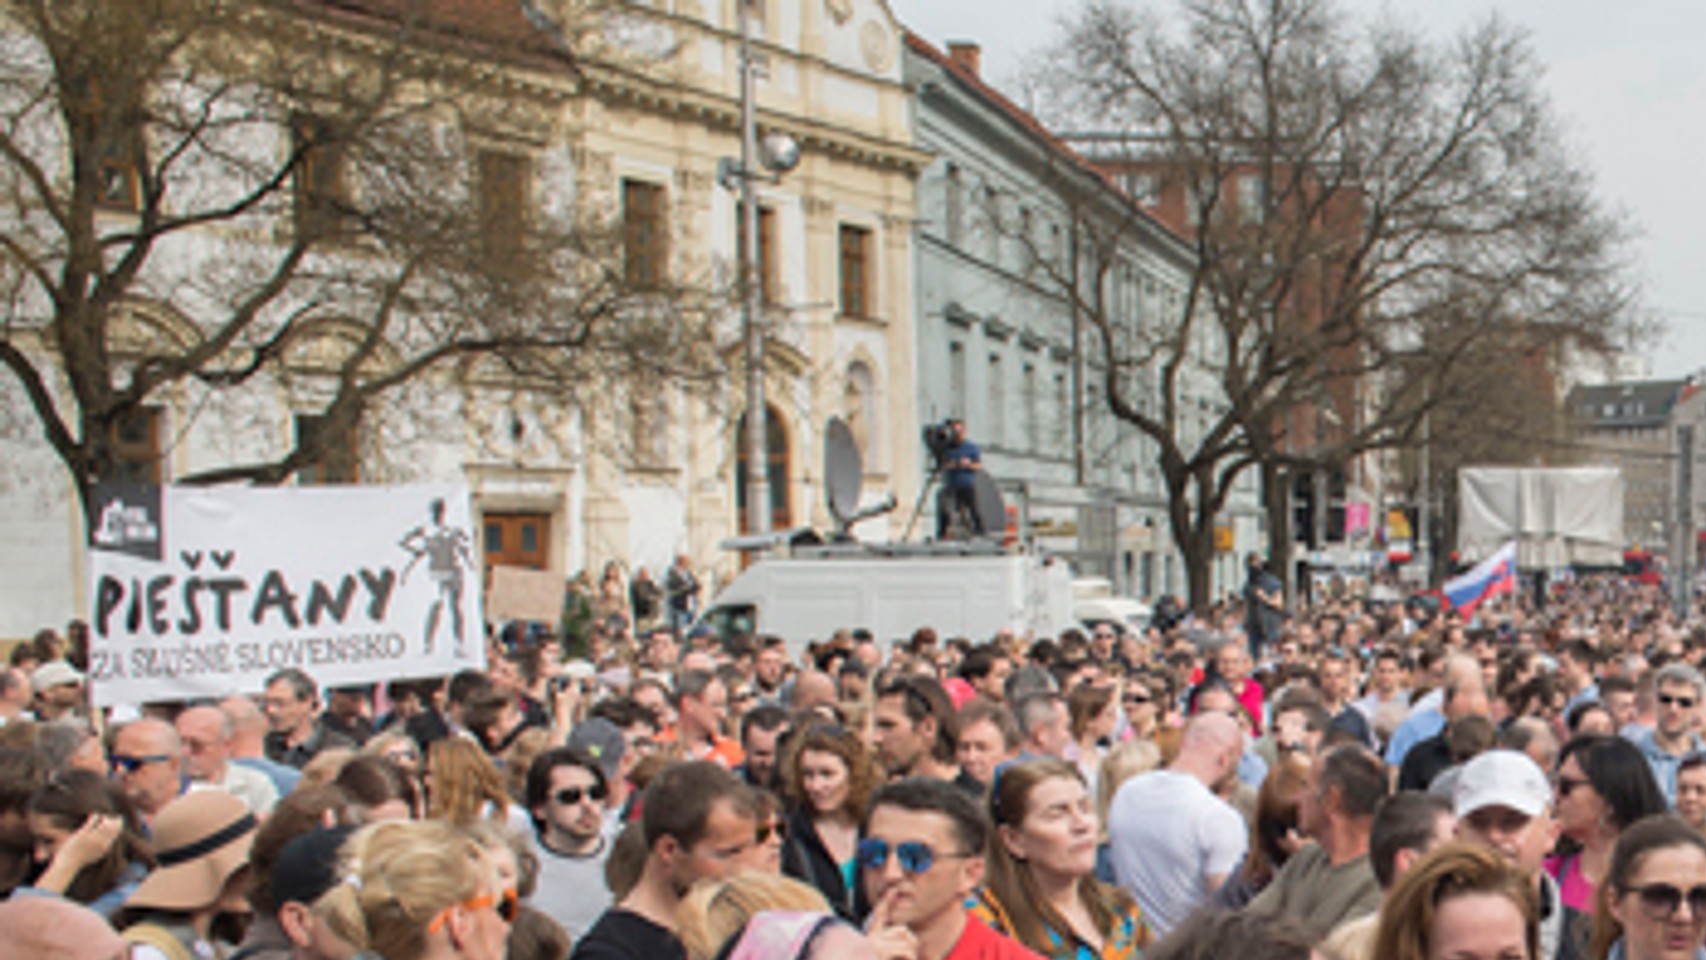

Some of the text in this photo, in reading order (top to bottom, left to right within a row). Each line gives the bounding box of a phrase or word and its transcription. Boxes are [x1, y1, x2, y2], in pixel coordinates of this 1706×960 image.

[96, 551, 396, 637] PIEŠŤANY
[90, 633, 407, 680] ZA SLUŠNÉ SLOVENSKO
